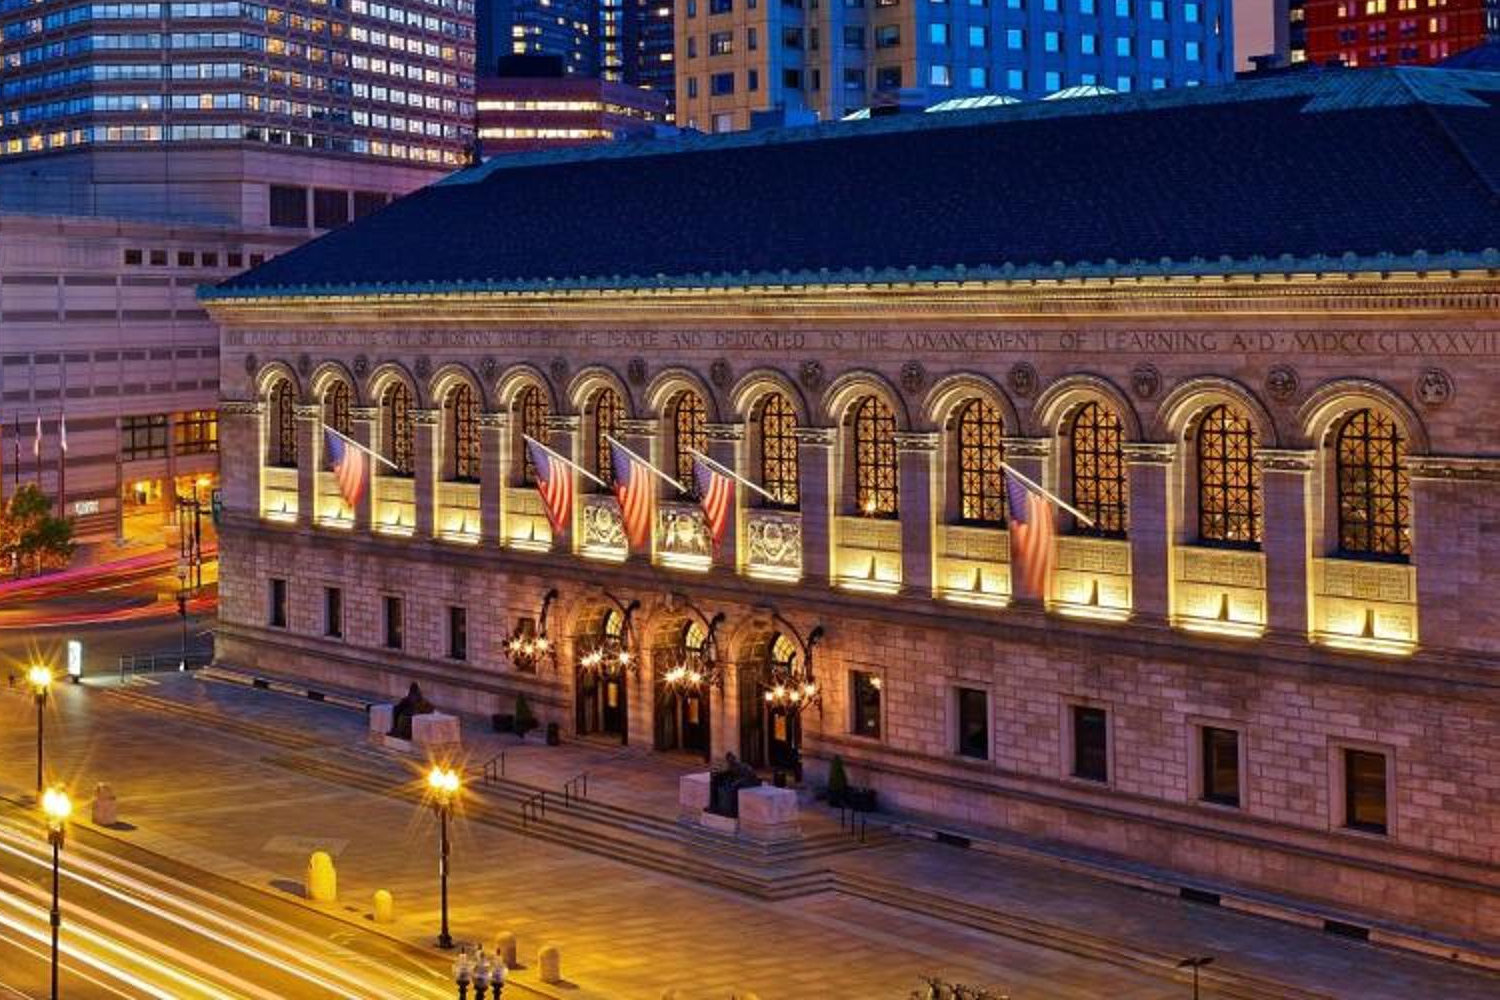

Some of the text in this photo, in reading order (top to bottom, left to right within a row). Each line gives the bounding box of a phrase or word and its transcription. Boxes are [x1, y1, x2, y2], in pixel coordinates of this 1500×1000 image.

[714, 331, 806, 349] DEDICATED
[855, 332, 887, 350] THE
[902, 332, 1044, 351] ADVANCEMENT
[1059, 332, 1090, 350] OF
[1103, 331, 1217, 352] LEARNING
